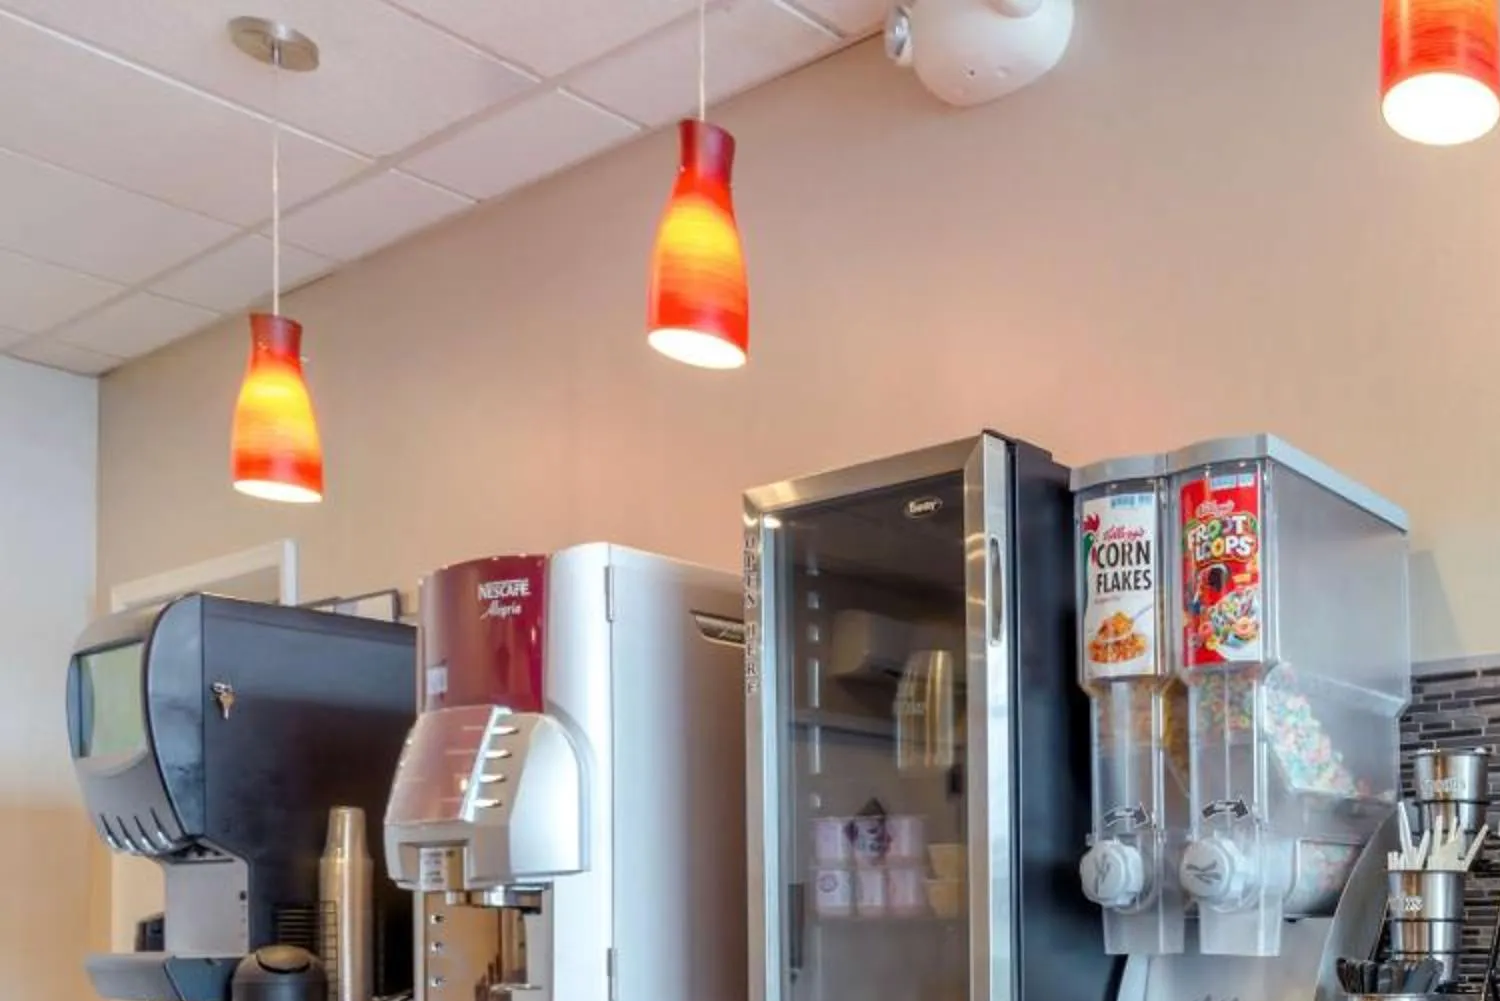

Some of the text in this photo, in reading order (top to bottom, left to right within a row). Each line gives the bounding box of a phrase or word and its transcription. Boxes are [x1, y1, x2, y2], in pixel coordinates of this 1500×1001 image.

[1187, 515, 1248, 551] FROOT
[1097, 540, 1151, 569] CORN
[1195, 535, 1251, 561] LOOPS
[1096, 569, 1152, 593] FLAKES
